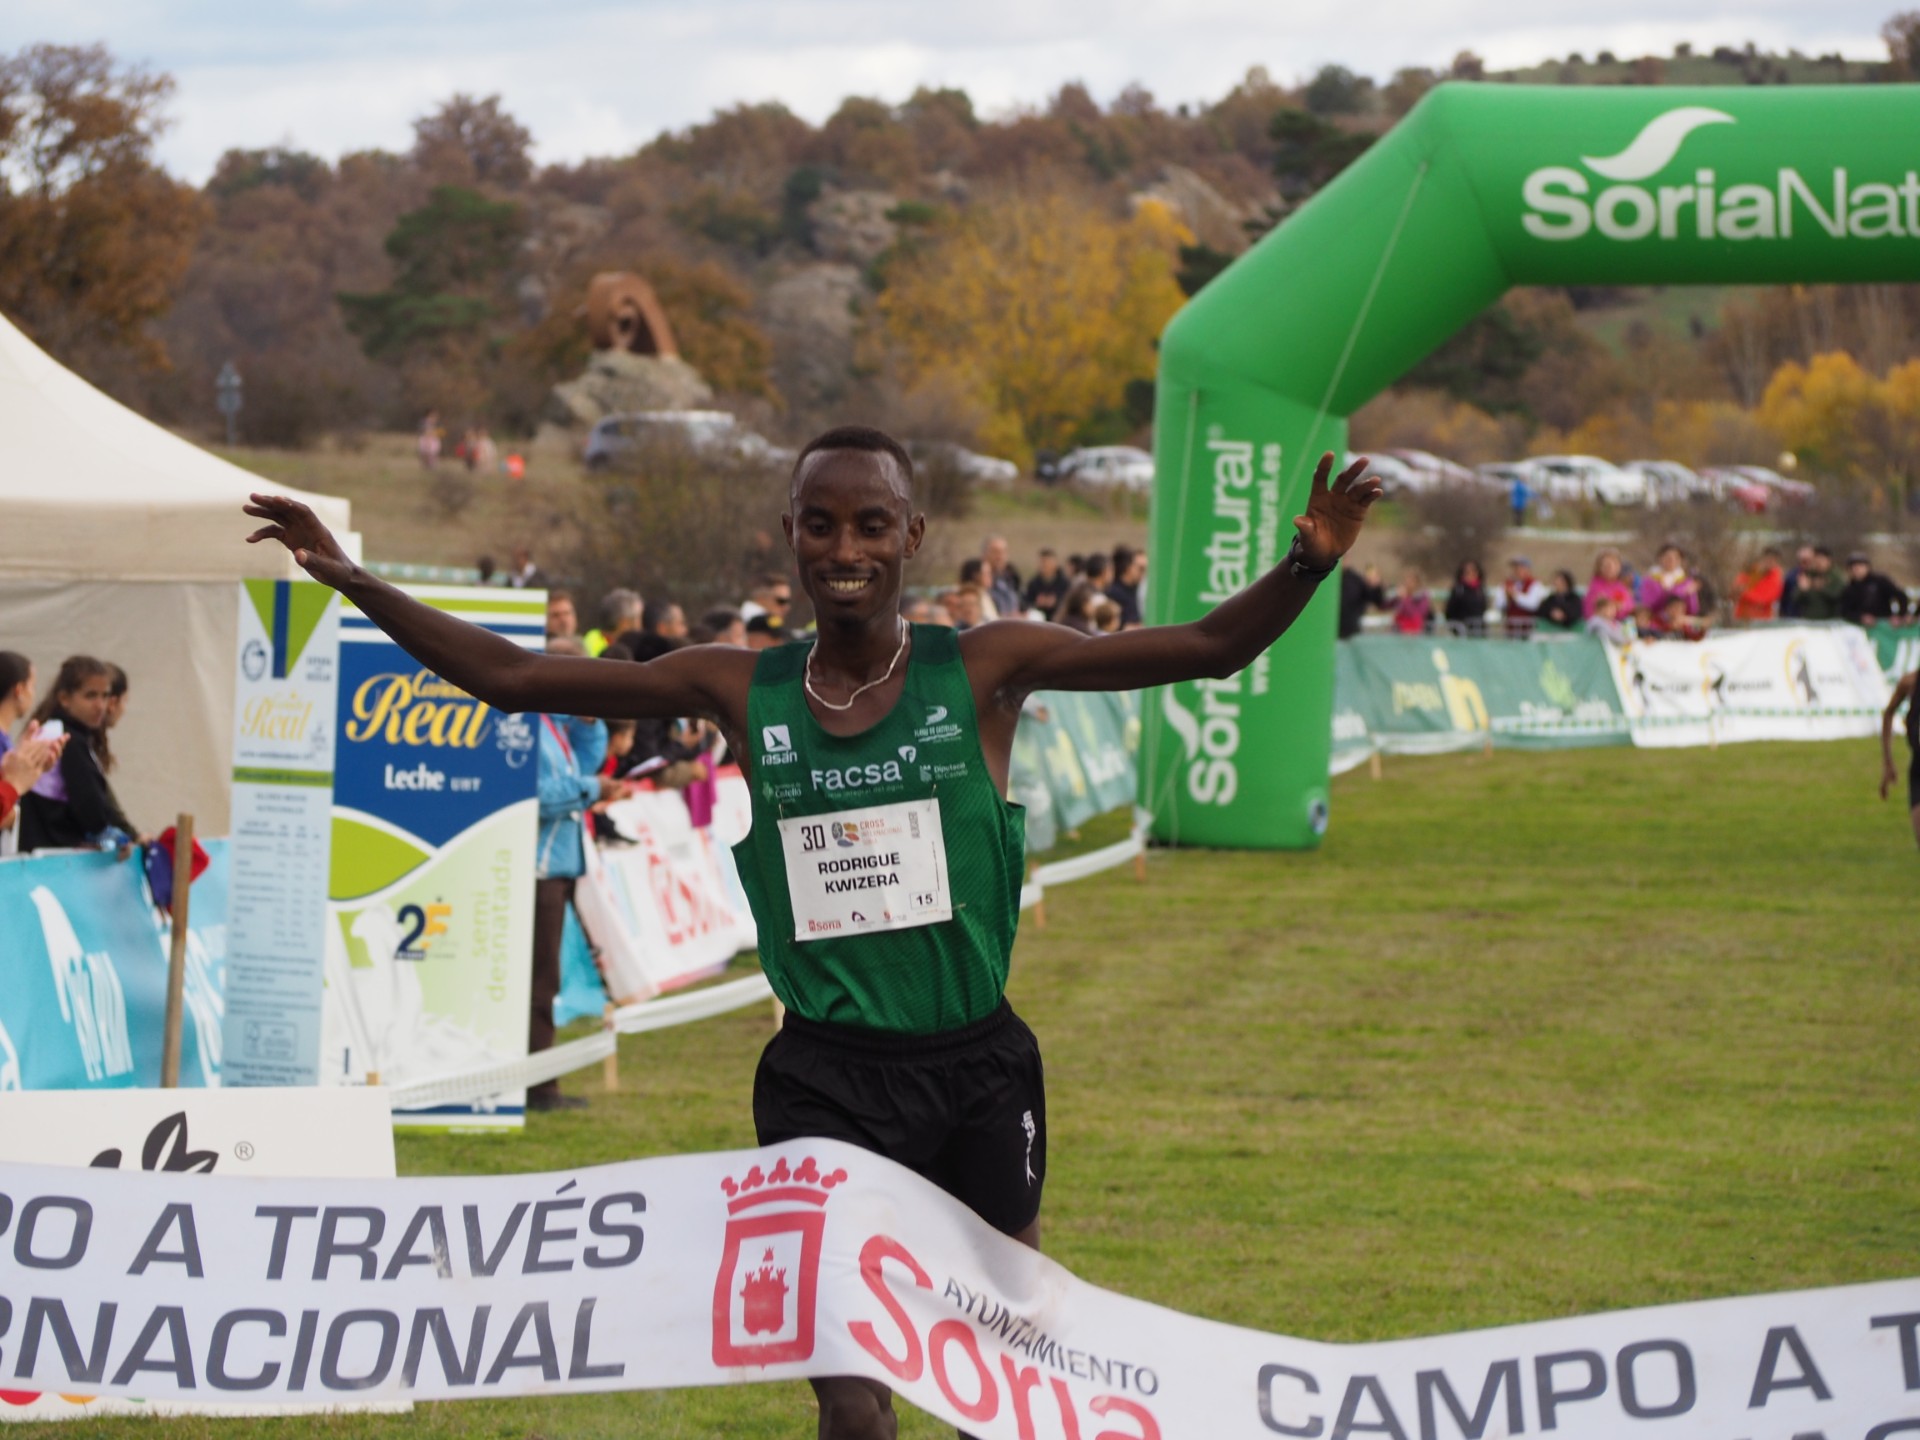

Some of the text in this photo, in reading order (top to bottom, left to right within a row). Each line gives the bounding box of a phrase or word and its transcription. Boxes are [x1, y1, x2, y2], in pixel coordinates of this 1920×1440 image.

[345, 672, 491, 749] Real
[384, 762, 445, 790] Leche
[801, 824, 826, 851] 30
[817, 852, 901, 875] RODRIGUE
[824, 872, 900, 894] KWIZERA
[916, 893, 933, 906] 15
[487, 848, 511, 1002] desnatada
[125, 1202, 205, 1278] A
[254, 1179, 647, 1281] TRAVÉS
[943, 1276, 1160, 1396] AYUNTAMIENTO
[1257, 1337, 1698, 1440] CAMPO
[1747, 1325, 1834, 1409] A
